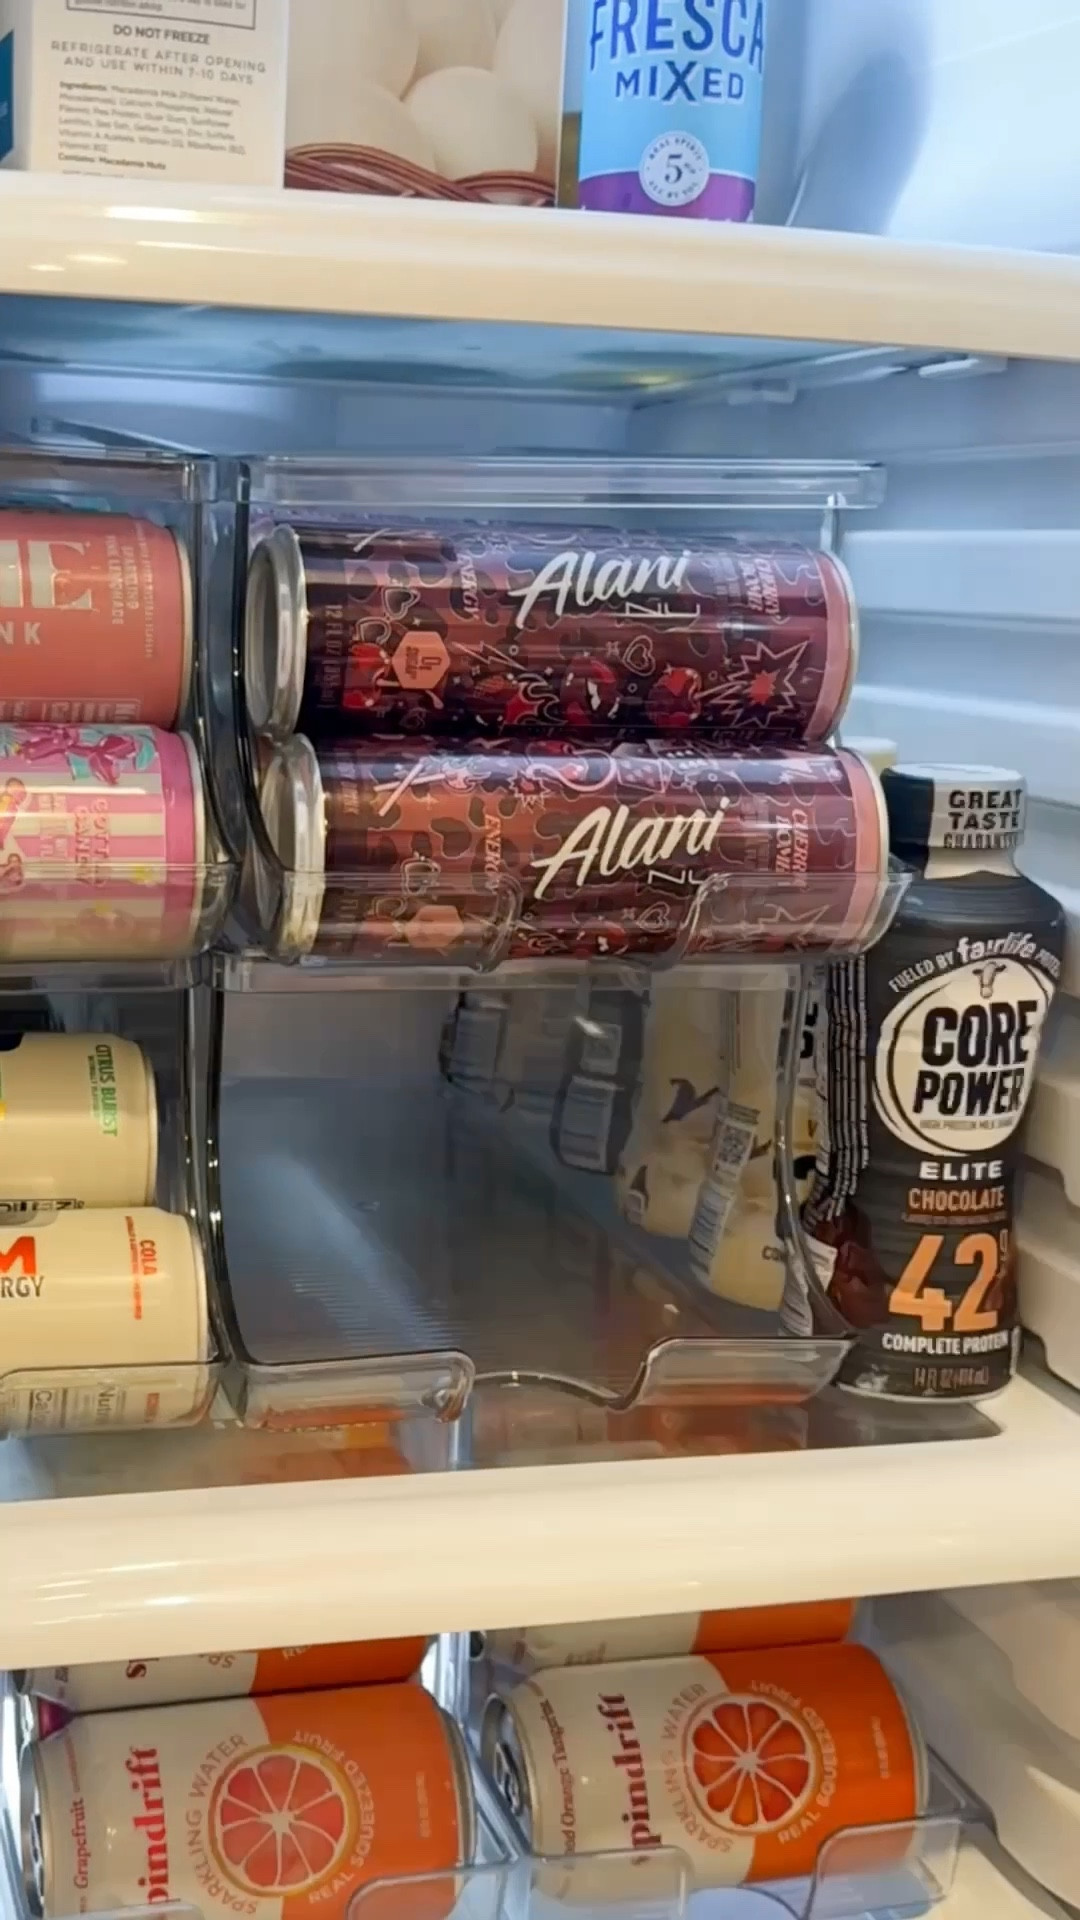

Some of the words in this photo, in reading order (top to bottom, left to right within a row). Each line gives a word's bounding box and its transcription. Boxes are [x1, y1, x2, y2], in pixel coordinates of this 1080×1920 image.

[113, 24, 132, 36] DO
[135, 27, 161, 39] NOT
[164, 30, 211, 45] FREEZE
[590, 0, 765, 73] FRESCA
[51, 40, 149, 60] REFRIGERATE
[155, 50, 200, 64] AFTER
[205, 55, 267, 74] OPENING
[64, 56, 94, 68] AND
[100, 58, 127, 71] USE
[133, 61, 184, 76] WITHIN
[189, 68, 215, 81] 7-10
[220, 72, 254, 85] DAYS
[615, 60, 744, 102] MIXED
[507, 549, 692, 630] Alani
[325, 603, 343, 620] 12
[949, 789, 1023, 810] GREAT
[948, 810, 1020, 830] TASTE
[531, 796, 730, 900] Alani
[888, 959, 936, 993] FUELED
[935, 951, 955, 970] BY
[957, 931, 1037, 964] fairlife
[921, 1000, 1039, 1068] CORE
[95, 1044, 116, 1083] CITRUS
[100, 1086, 118, 1137] BURST
[912, 1067, 1025, 1117] POWER
[919, 1160, 1003, 1181] ELITE
[908, 1185, 1005, 1212] CHOCOLATE
[140, 1239, 158, 1276] COLA
[882, 1333, 961, 1355] COMPLETE
[962, 1329, 1009, 1355] PROTEIN
[660, 1683, 707, 1740] WATER
[292, 1730, 345, 1761] FRUIT
[188, 1733, 249, 1798] WATER
[343, 1759, 376, 1868] SQUEEZED
[776, 1811, 822, 1845] REAL
[72, 1798, 90, 1890] Grapefruit
[185, 1808, 258, 1914] SPARKLING
[308, 1871, 355, 1904] REAL
